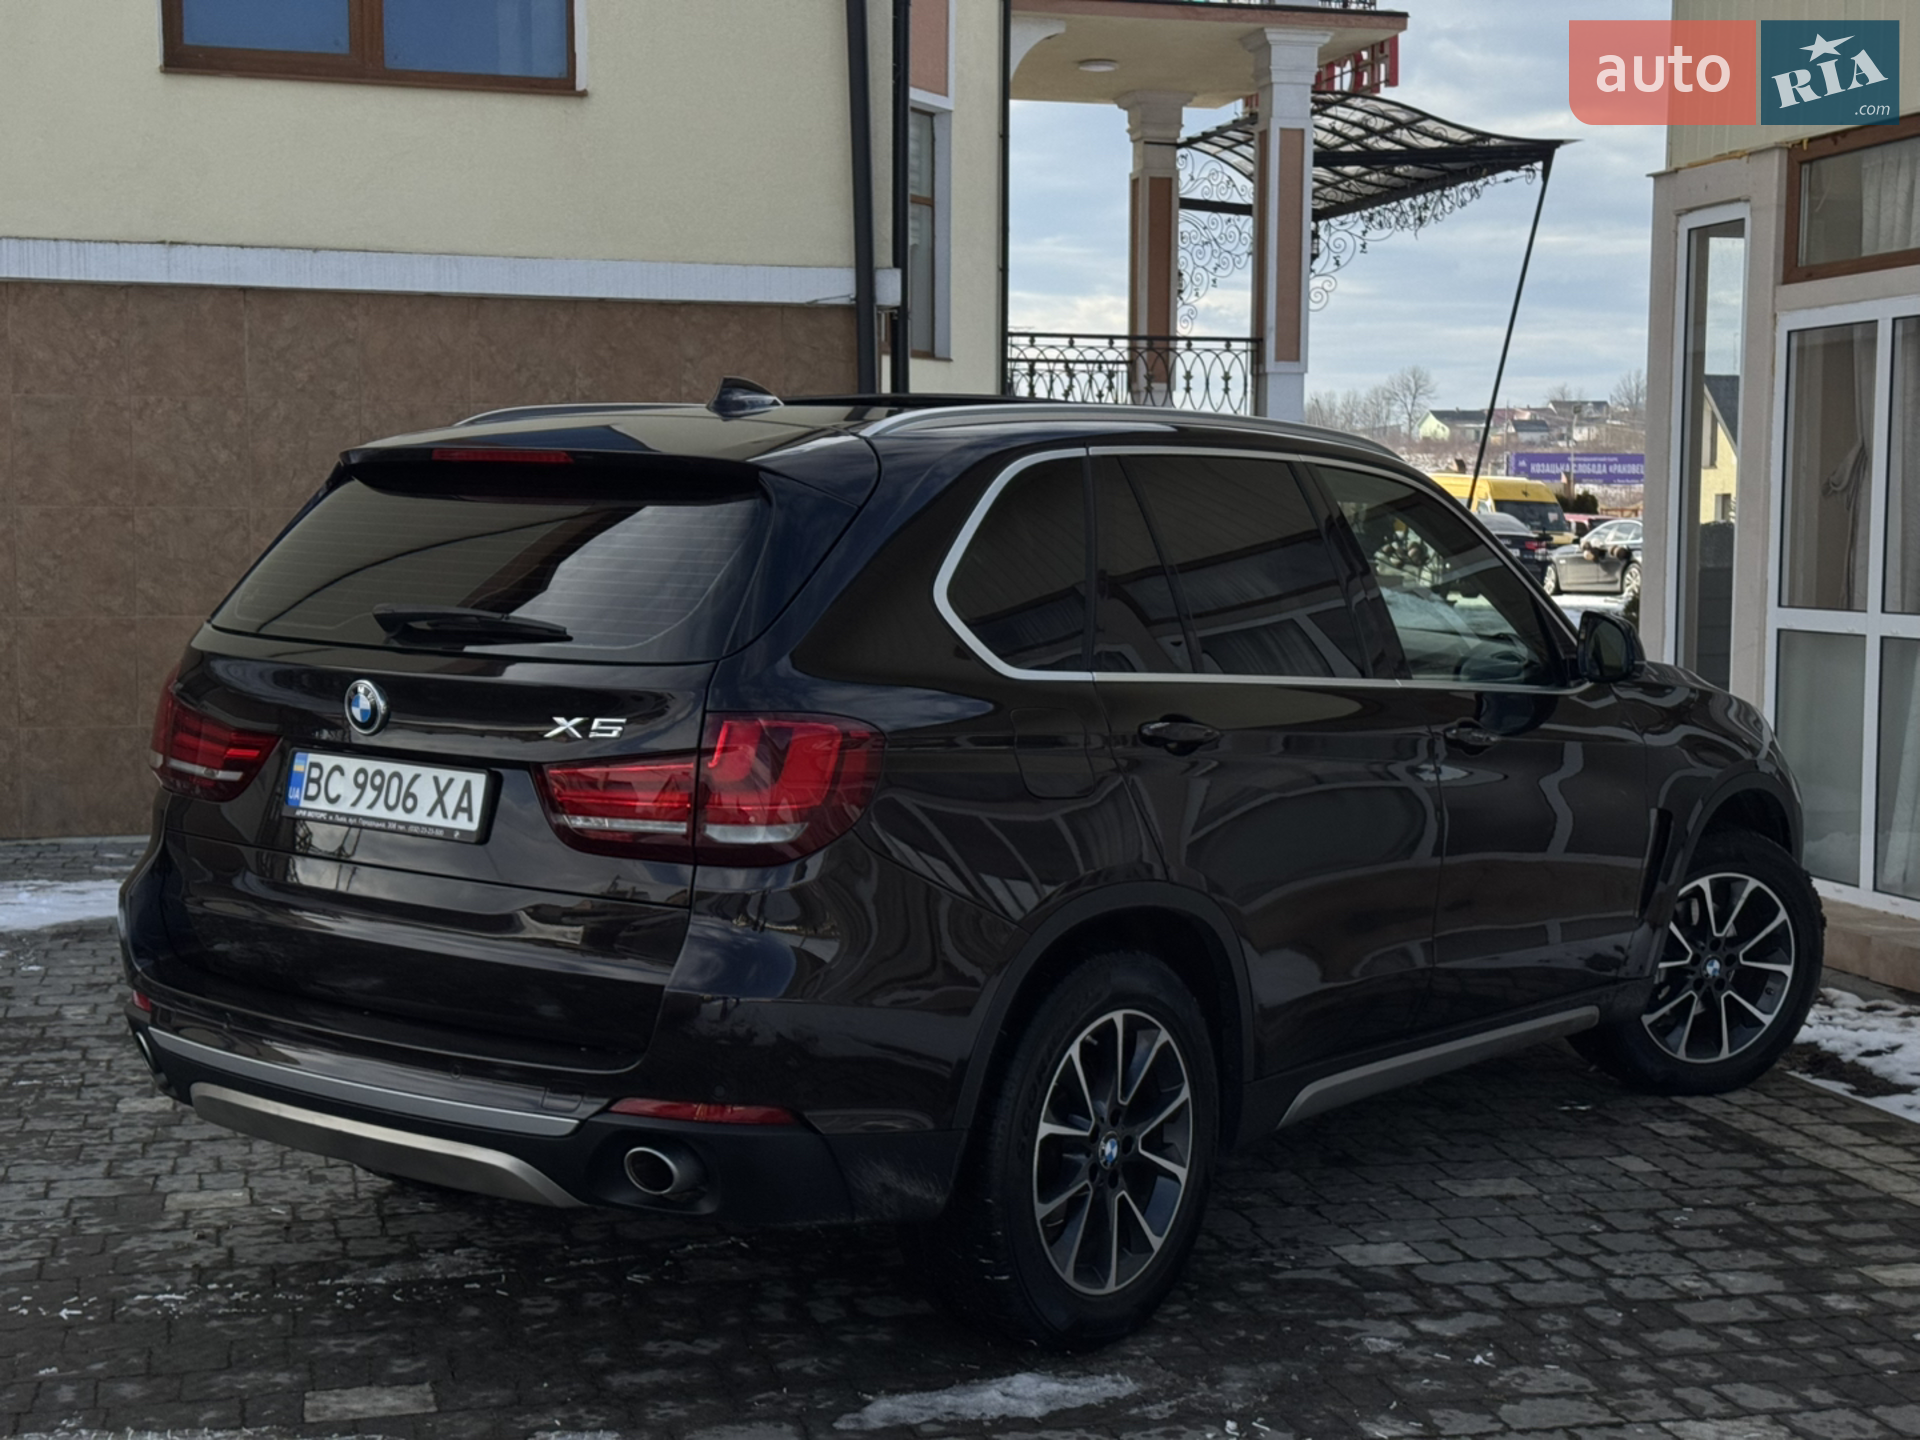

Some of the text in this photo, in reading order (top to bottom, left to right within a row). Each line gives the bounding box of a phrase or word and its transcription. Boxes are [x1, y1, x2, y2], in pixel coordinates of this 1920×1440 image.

[543, 716, 627, 739] X5
[288, 786, 300, 800] UA
[303, 761, 474, 823] BC 9906 XA
